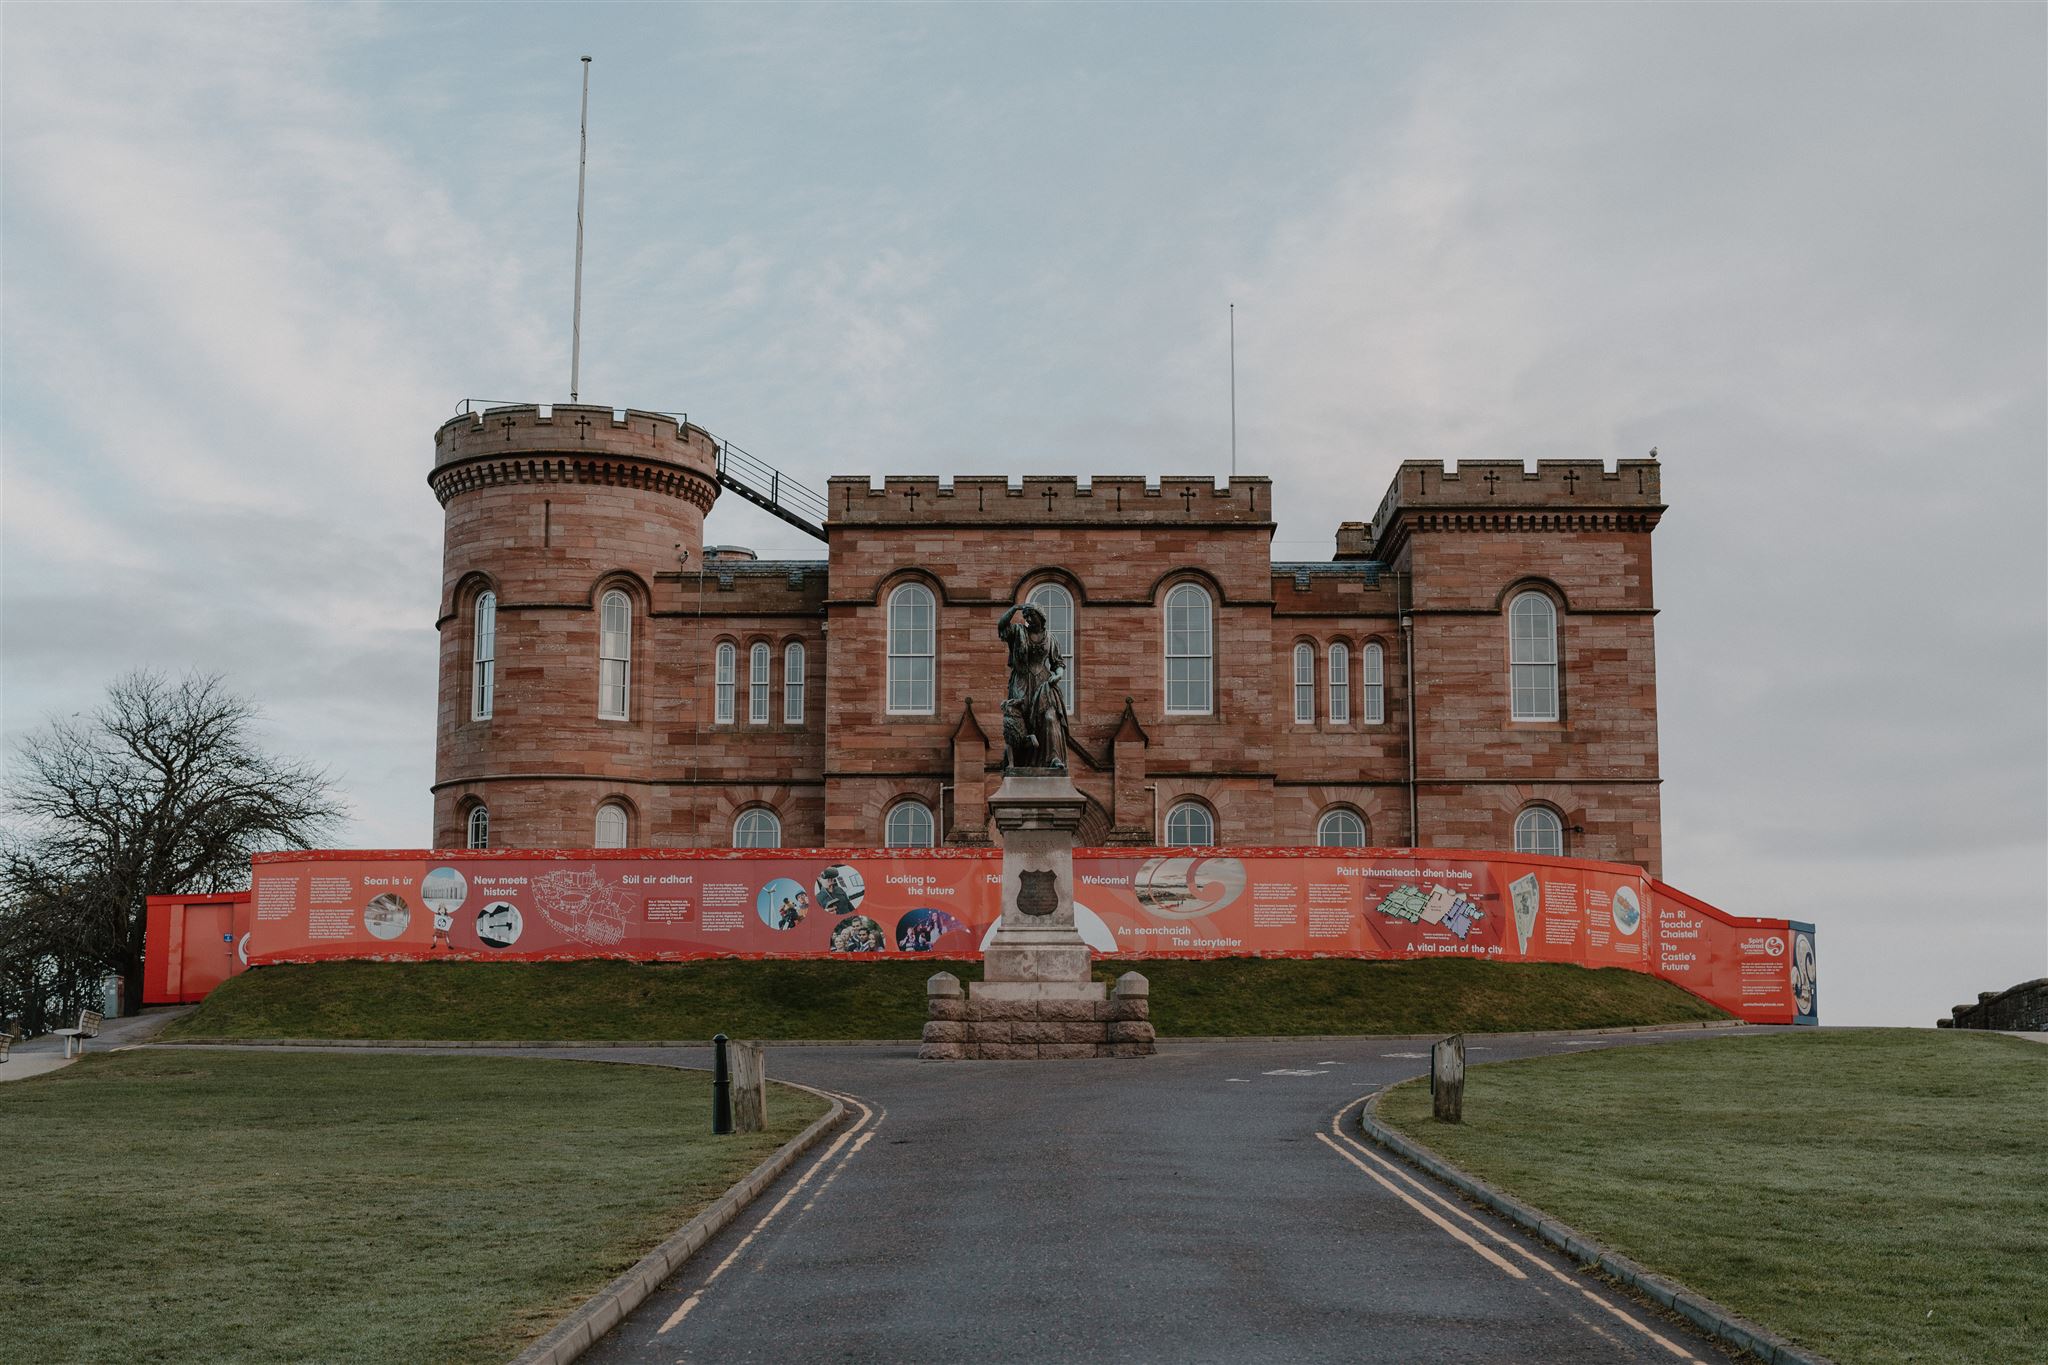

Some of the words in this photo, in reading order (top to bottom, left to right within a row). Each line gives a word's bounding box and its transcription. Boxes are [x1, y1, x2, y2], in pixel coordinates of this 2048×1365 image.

[1336, 866, 1359, 877] Pàirt
[1362, 867, 1421, 878] bhunaiteach
[1422, 868, 1445, 878] dhen
[1446, 869, 1473, 879] bhaile
[364, 876, 388, 885] Sean
[392, 876, 400, 885] is
[474, 876, 496, 885] New
[499, 876, 528, 885] meets
[622, 875, 640, 884] Sùil
[643, 875, 657, 884] air
[660, 875, 693, 884] adhart
[886, 875, 924, 886] Looking
[926, 875, 937, 884] to
[1082, 875, 1129, 885] Welcome!
[483, 887, 518, 896] historic
[908, 886, 923, 895] the
[927, 886, 955, 895] future
[1660, 908, 1676, 919] Àm
[1677, 910, 1686, 919] Ri
[1660, 920, 1693, 928] Teachd
[1118, 926, 1131, 935] An
[1134, 926, 1191, 935] seanchaidh
[1660, 929, 1698, 939] Chaisteil
[1172, 937, 1190, 946] The
[1193, 937, 1242, 949] storyteller
[1660, 942, 1677, 951] The
[1406, 942, 1414, 951] A
[1417, 942, 1436, 952] vital
[1439, 943, 1458, 953] part
[1460, 943, 1469, 953] of
[1471, 943, 1485, 953] the
[1488, 944, 1503, 955] city
[1661, 952, 1697, 961] Castle's
[1662, 962, 1690, 971] Future
